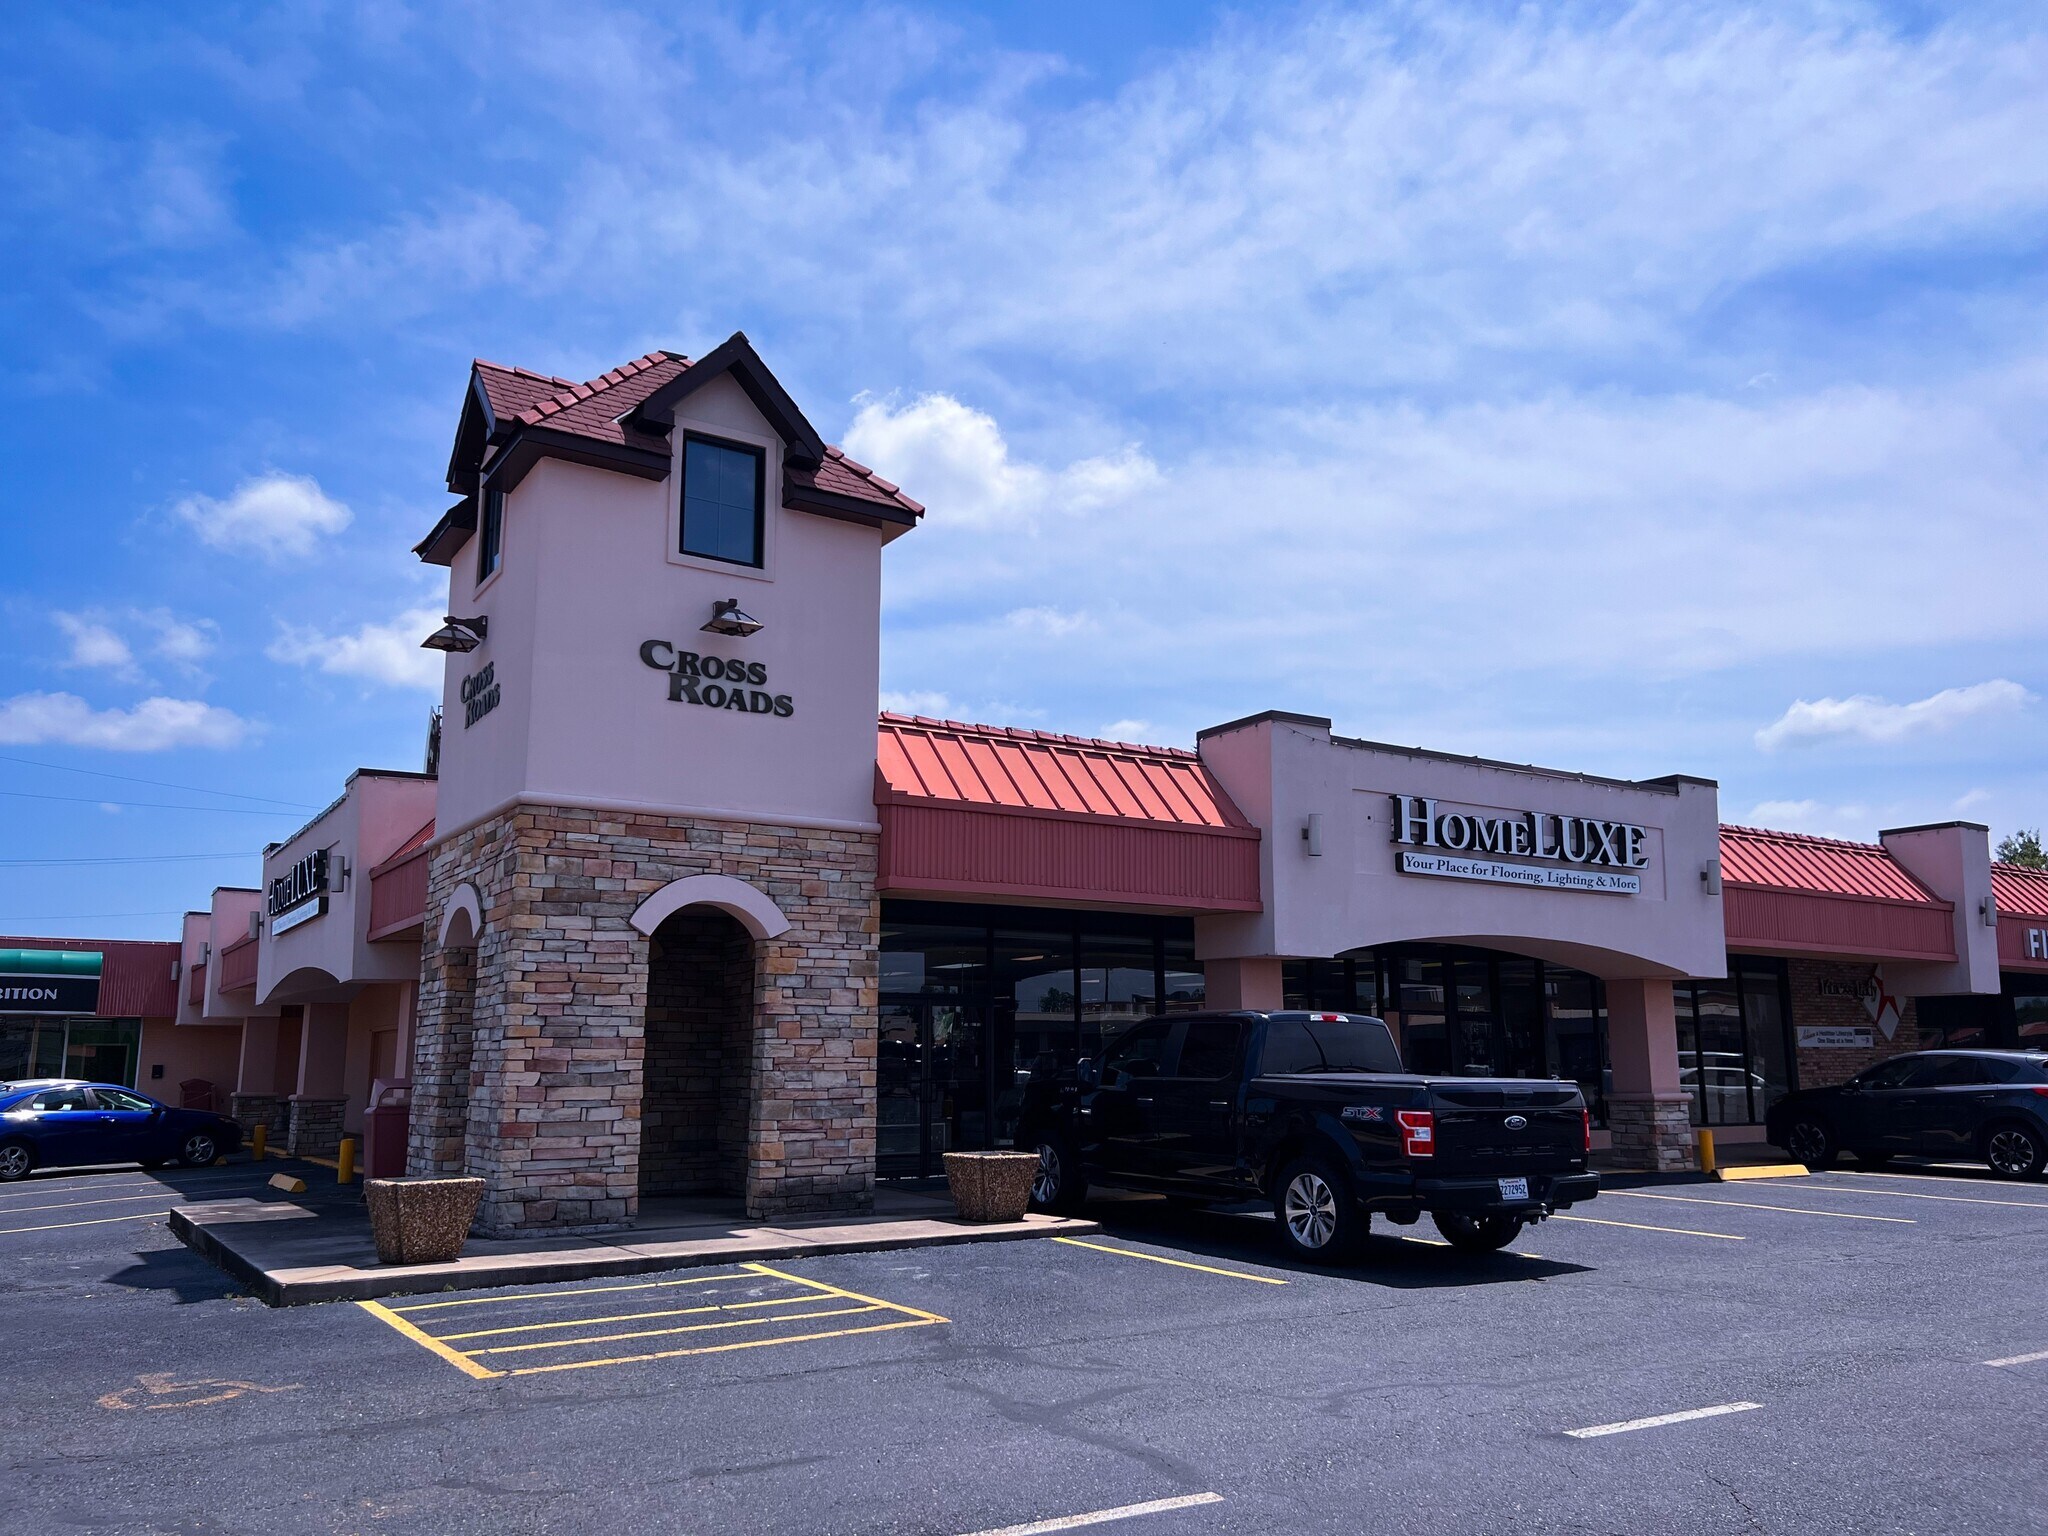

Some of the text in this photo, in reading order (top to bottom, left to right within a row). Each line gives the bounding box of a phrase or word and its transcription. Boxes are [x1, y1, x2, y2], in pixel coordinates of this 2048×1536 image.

[639, 639, 768, 686] CROSS
[666, 671, 795, 718] ROADS
[1404, 855, 1637, 890] Your Place for Flooring, Lighting & More
[1341, 1106, 1383, 1121] STX
